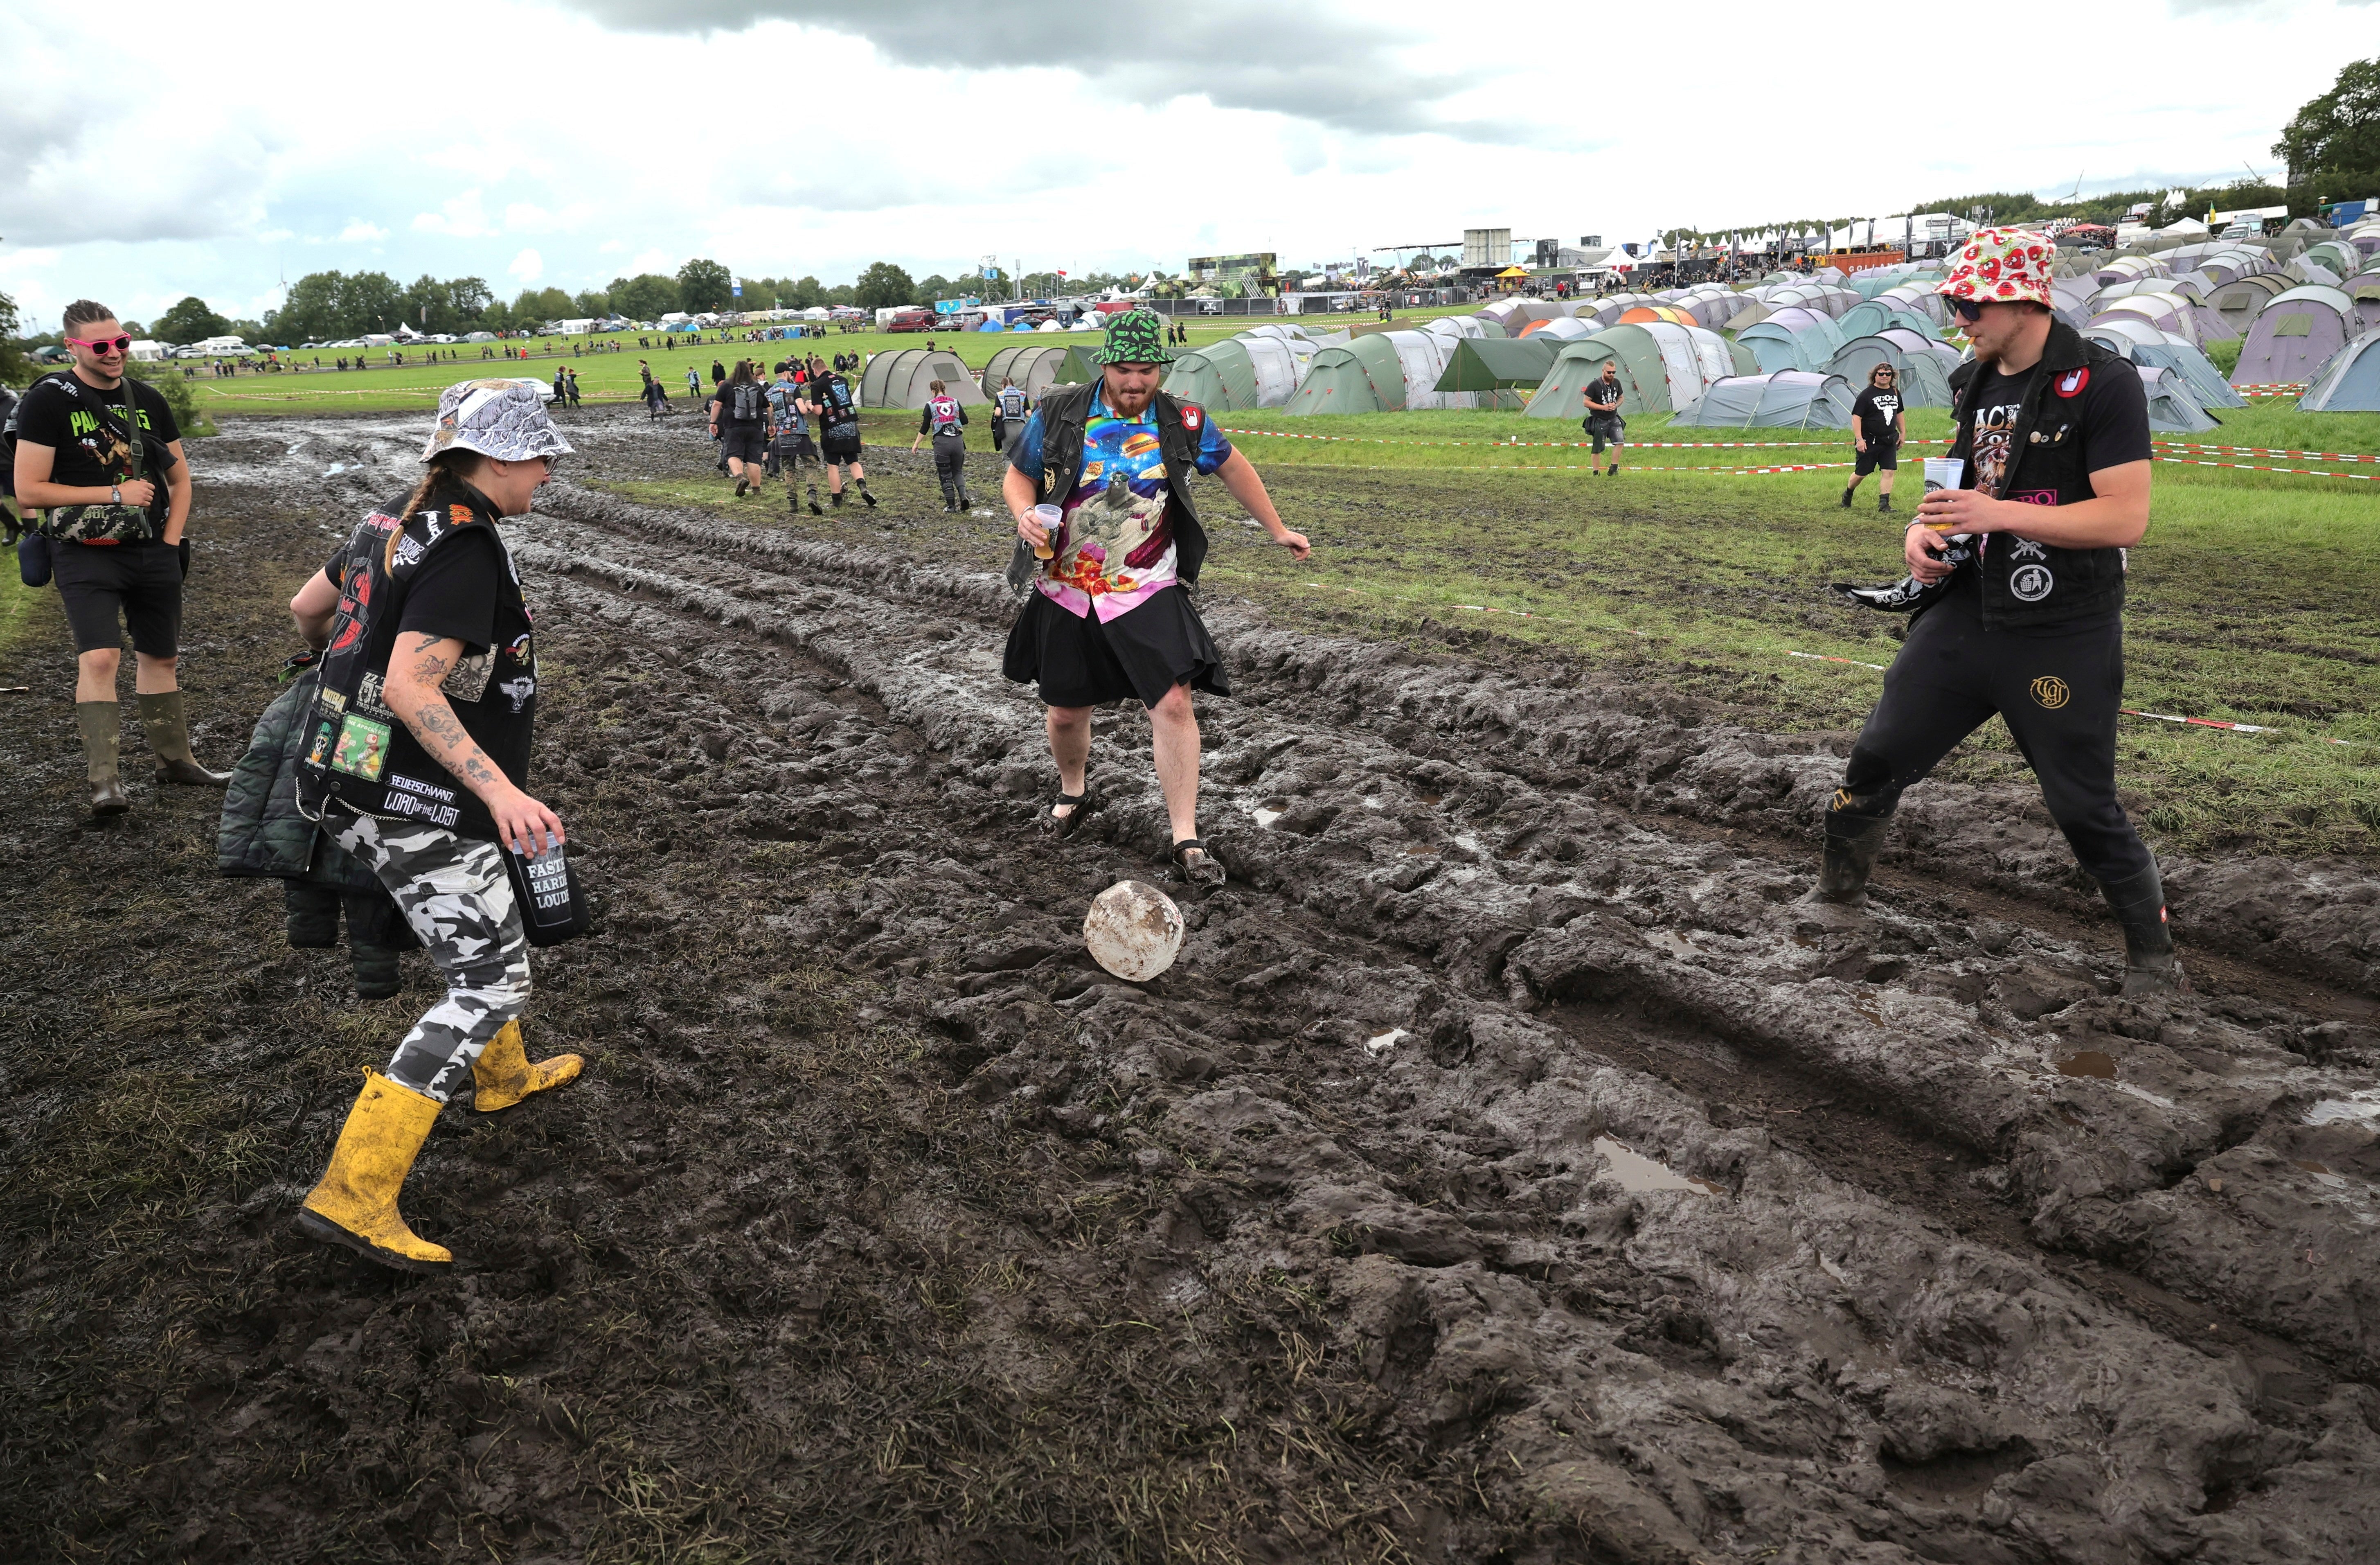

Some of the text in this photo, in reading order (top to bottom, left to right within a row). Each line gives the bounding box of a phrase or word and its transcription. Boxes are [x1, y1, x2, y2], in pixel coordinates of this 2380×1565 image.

[84, 508, 109, 519] JBL
[356, 700, 370, 710] TRES
[356, 723, 388, 736] APOCALYPSE
[390, 774, 454, 802] FEUERSCHWANZ
[384, 791, 417, 815] LORD
[414, 803, 423, 812] OF
[430, 803, 460, 827] LOST
